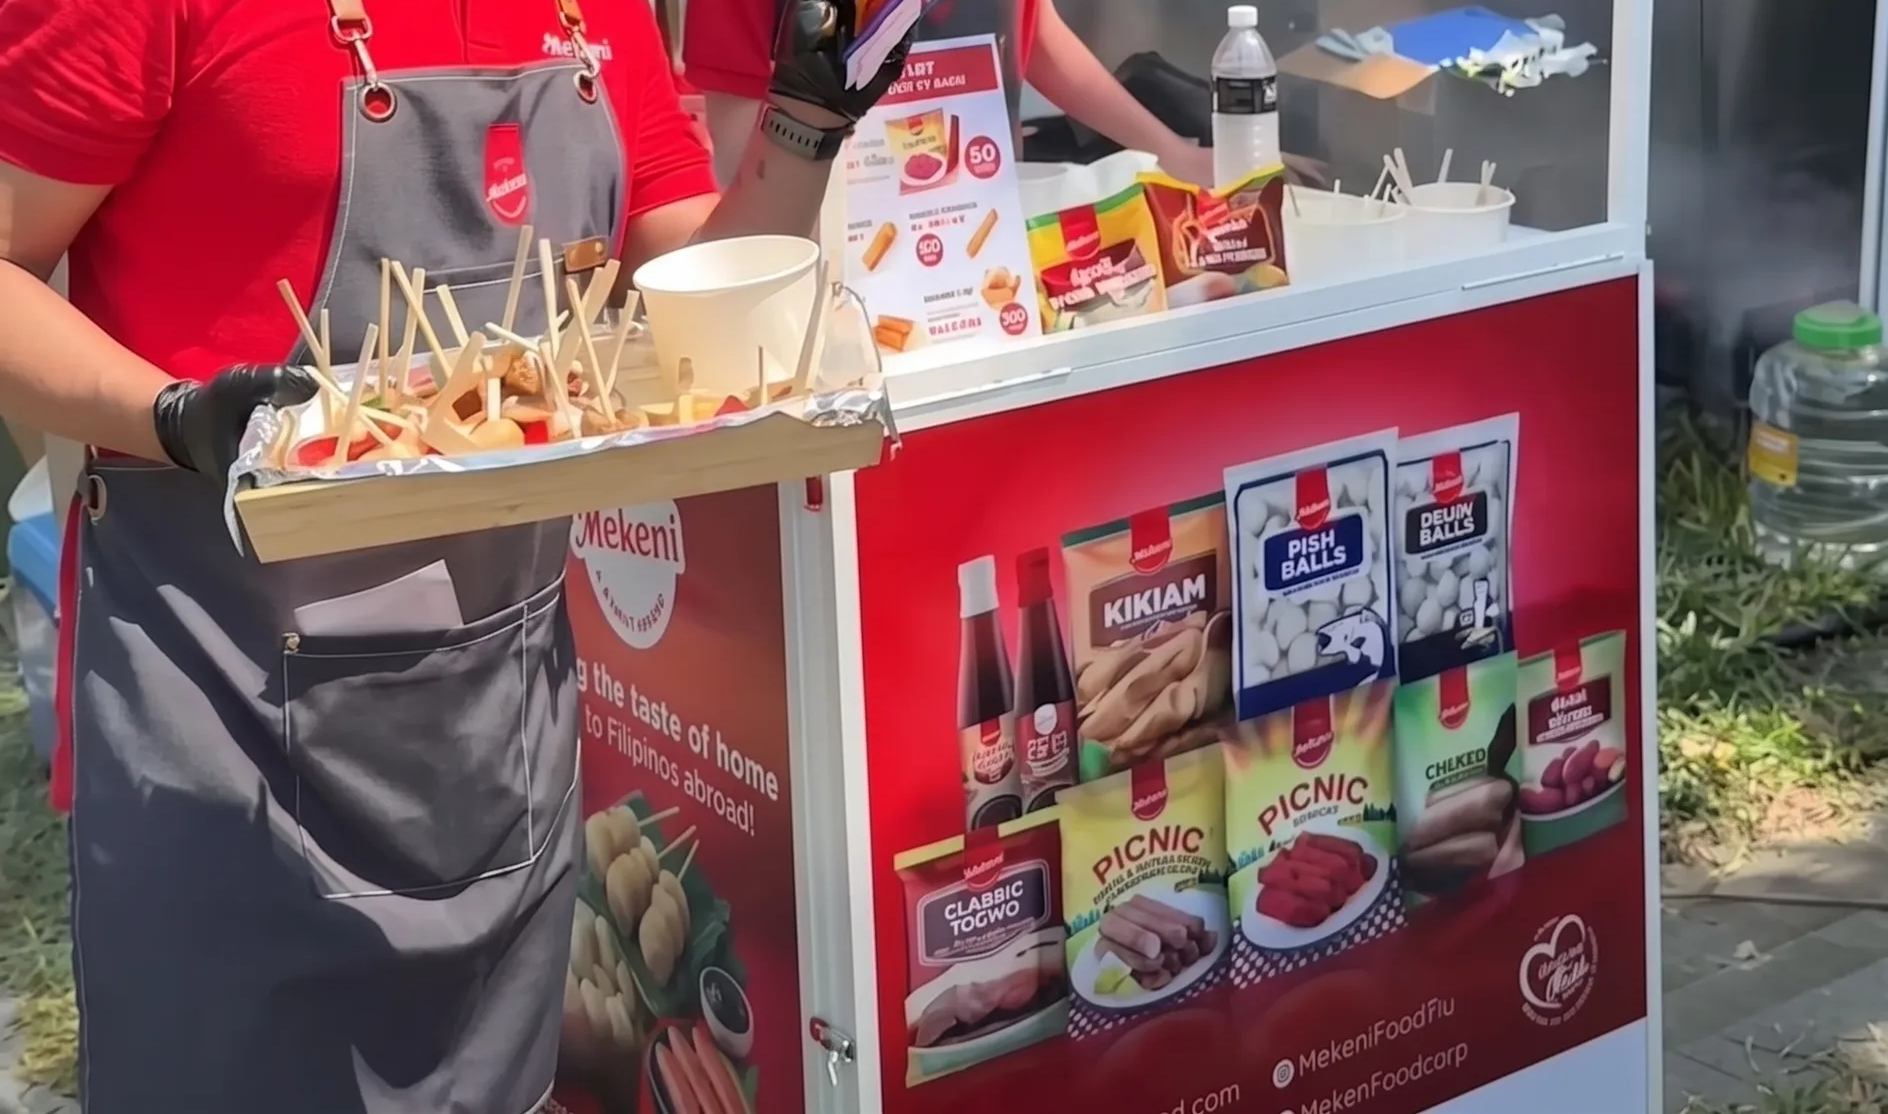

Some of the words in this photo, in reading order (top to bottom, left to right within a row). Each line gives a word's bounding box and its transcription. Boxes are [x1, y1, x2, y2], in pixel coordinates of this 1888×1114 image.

[969, 143, 996, 164] 50
[575, 507, 679, 563] Mekeni
[1419, 516, 1475, 547] BALLS
[1280, 545, 1347, 582] BALLS
[1103, 573, 1206, 628] KIKIAM
[593, 662, 625, 709] the
[630, 684, 682, 742] taste
[687, 723, 711, 760] of
[715, 730, 780, 802] home
[585, 703, 603, 739] to
[607, 716, 680, 787] Filipinos
[683, 769, 755, 837] abroad!
[1257, 773, 1369, 836] PICNIC
[1091, 824, 1205, 885] PICNIC
